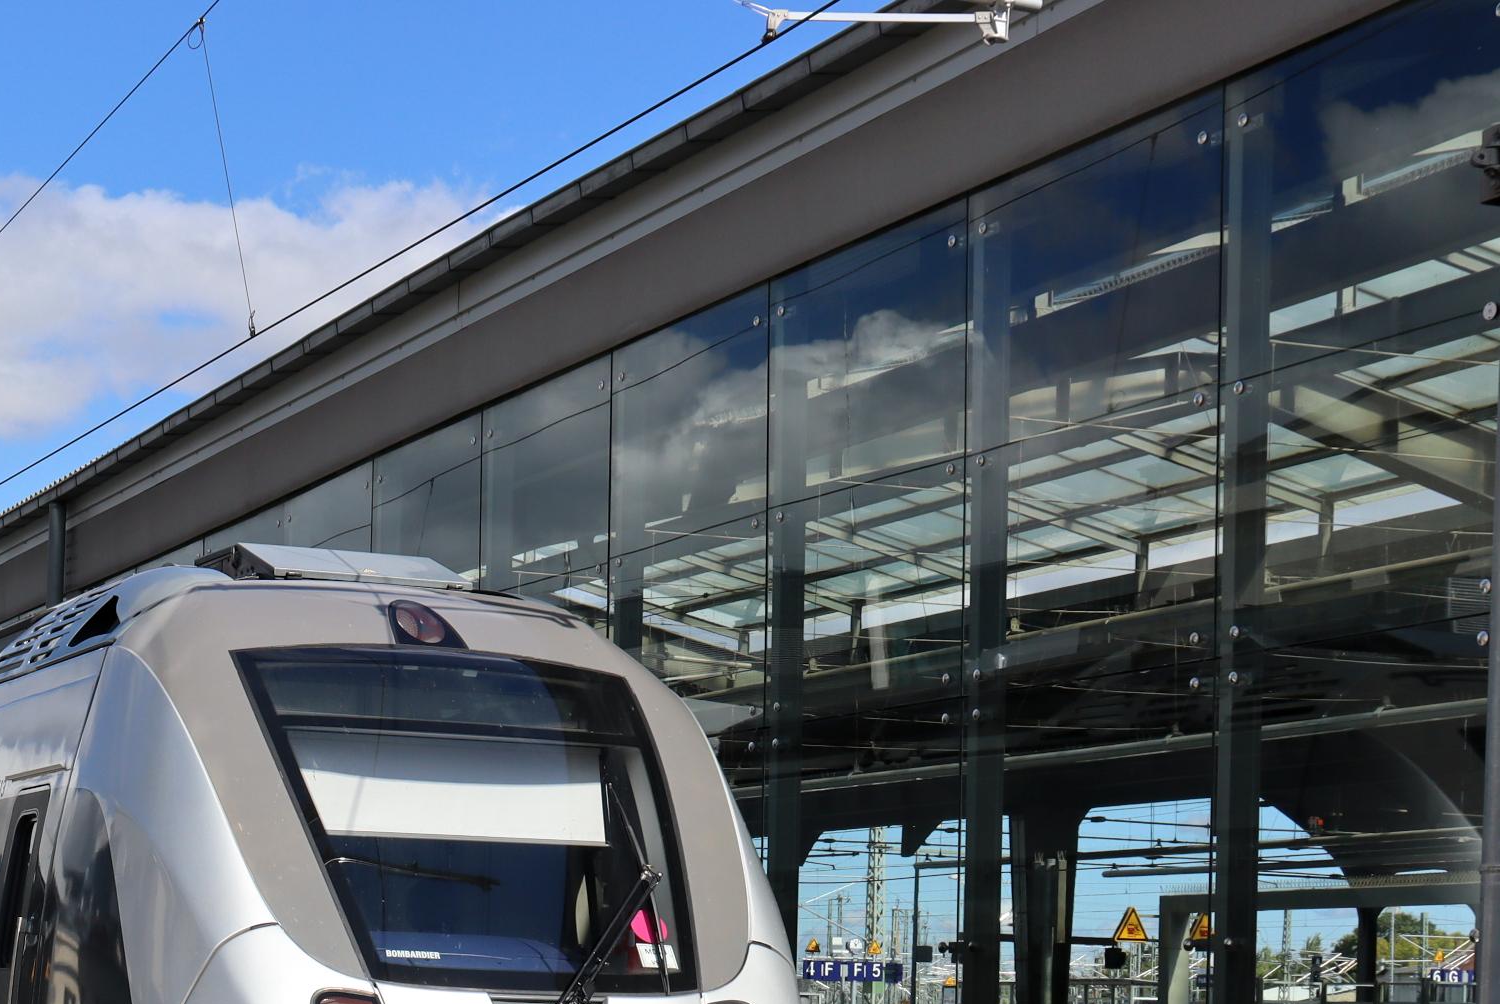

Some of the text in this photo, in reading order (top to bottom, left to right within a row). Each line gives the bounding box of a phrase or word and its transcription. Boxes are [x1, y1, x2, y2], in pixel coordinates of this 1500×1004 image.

[385, 949, 441, 960] BOMBARDIER
[806, 962, 834, 977] 4 F
[854, 963, 881, 978] F 5
[1448, 971, 1459, 983] G
